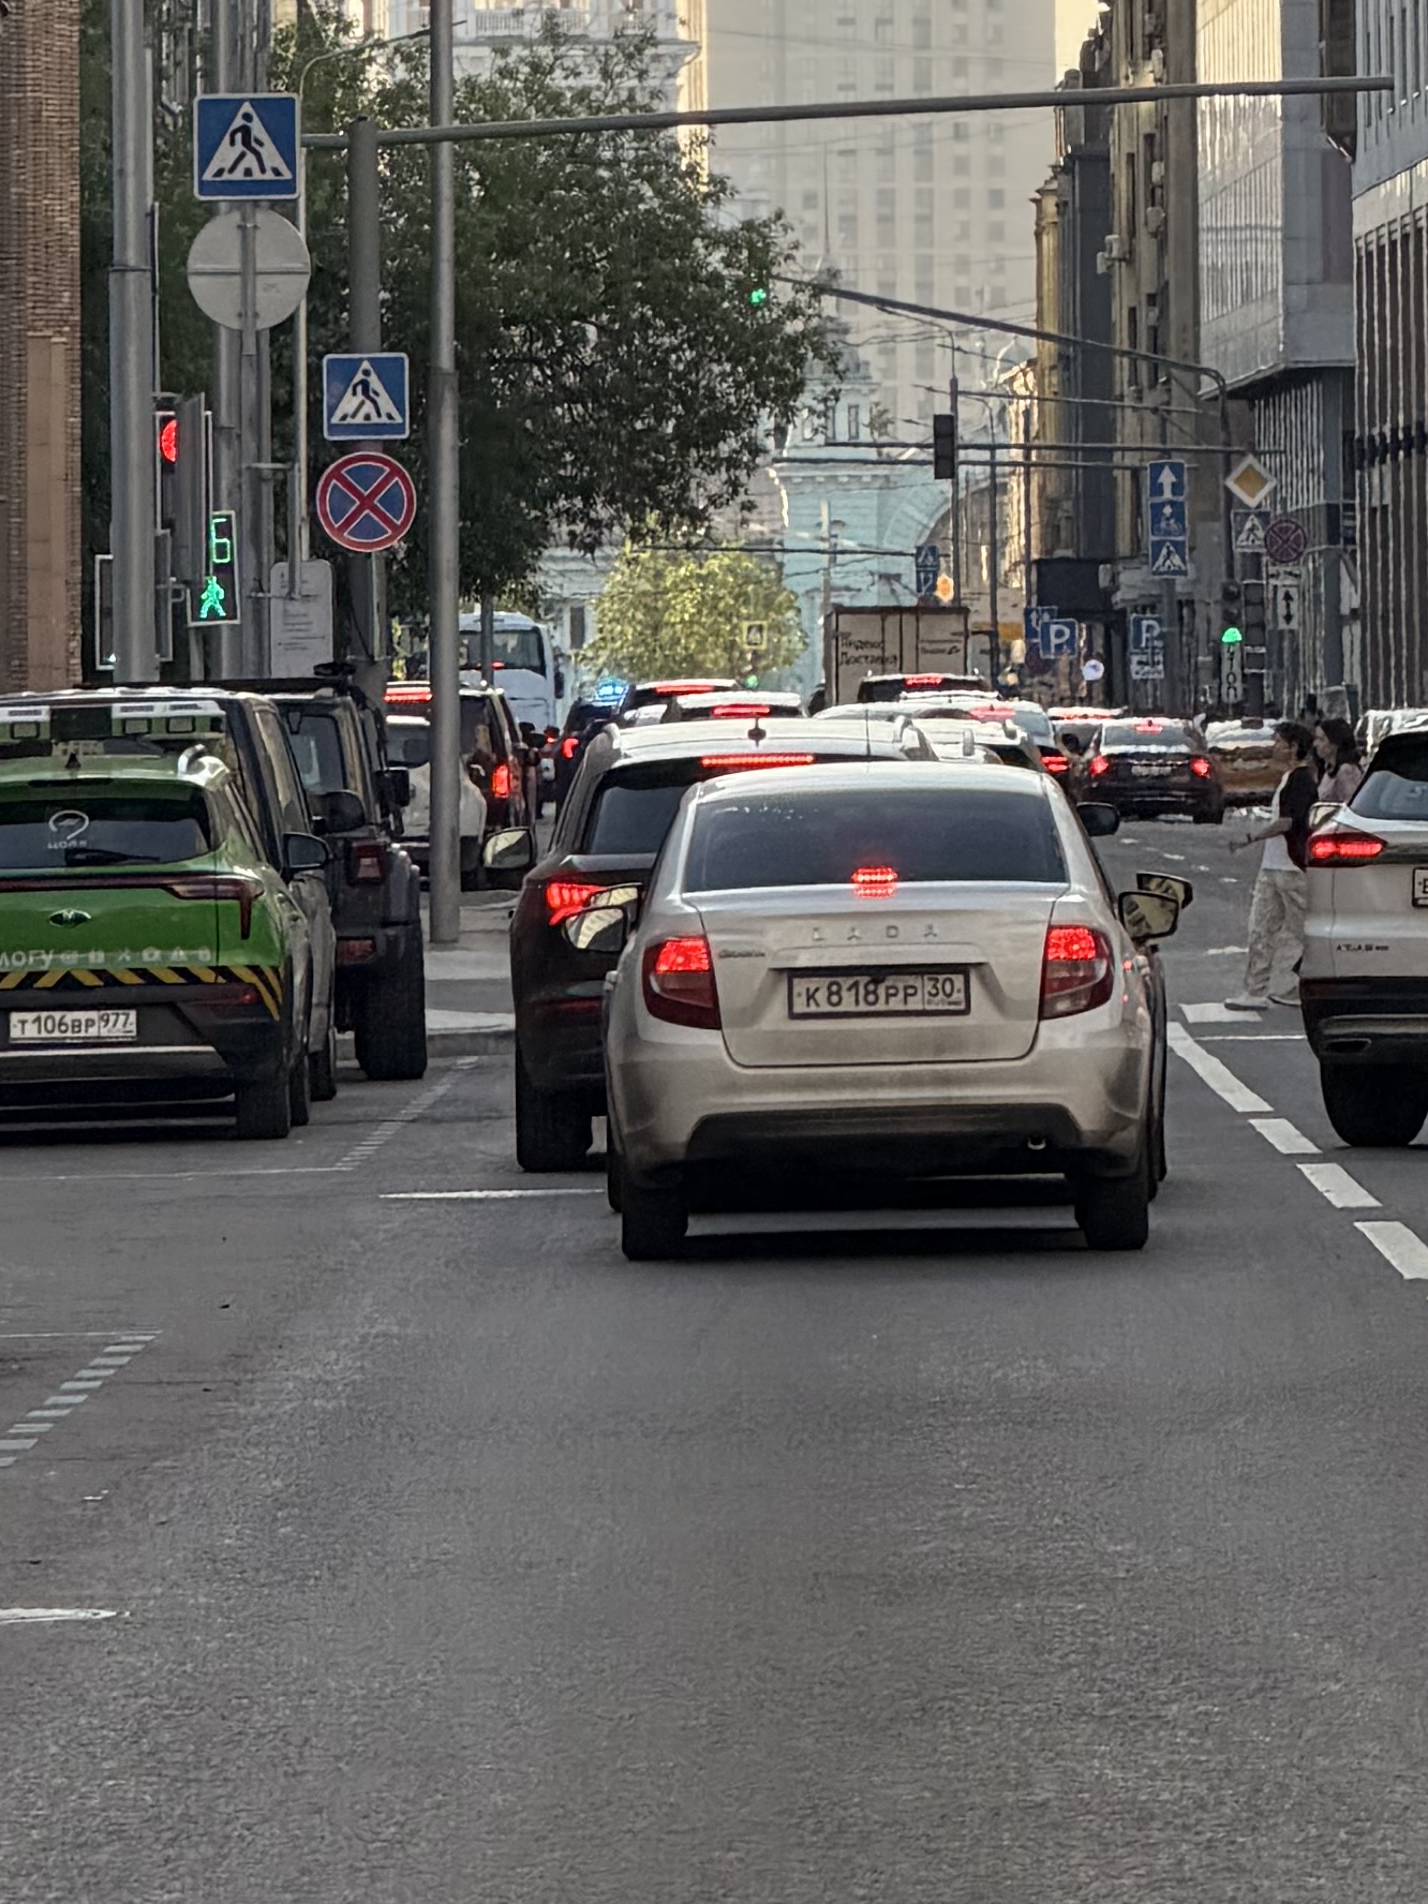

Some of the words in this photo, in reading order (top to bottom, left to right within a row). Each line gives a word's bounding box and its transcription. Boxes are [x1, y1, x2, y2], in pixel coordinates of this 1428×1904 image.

[211, 518, 231, 563] 6
[805, 979, 918, 1008] К818РР
[926, 976, 954, 998] 30
[17, 1014, 96, 1035] Т106ВР
[100, 1012, 130, 1029] 977
